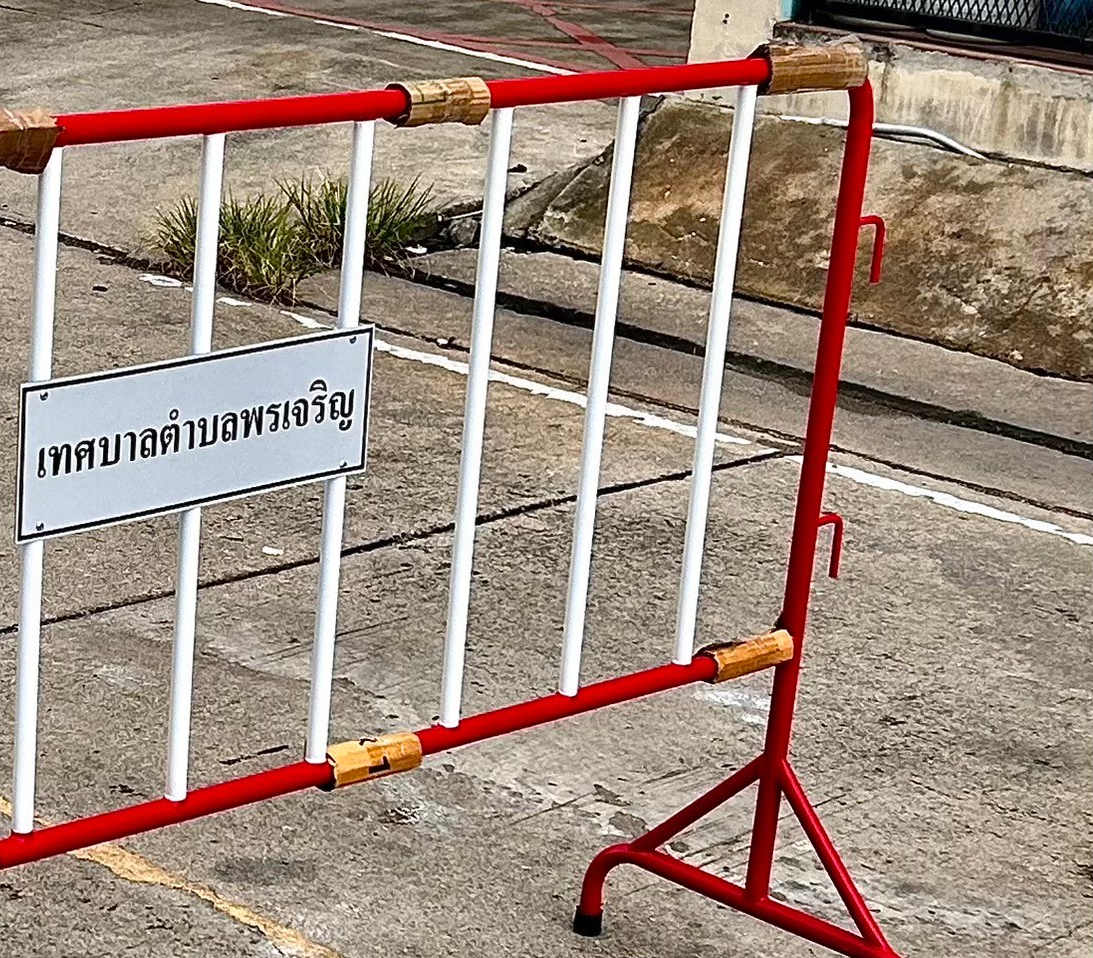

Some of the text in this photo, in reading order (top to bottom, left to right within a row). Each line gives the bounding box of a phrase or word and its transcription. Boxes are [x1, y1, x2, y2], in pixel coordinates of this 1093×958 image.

[36, 379, 355, 479] เทศบาลตำบลพรเจริญ
